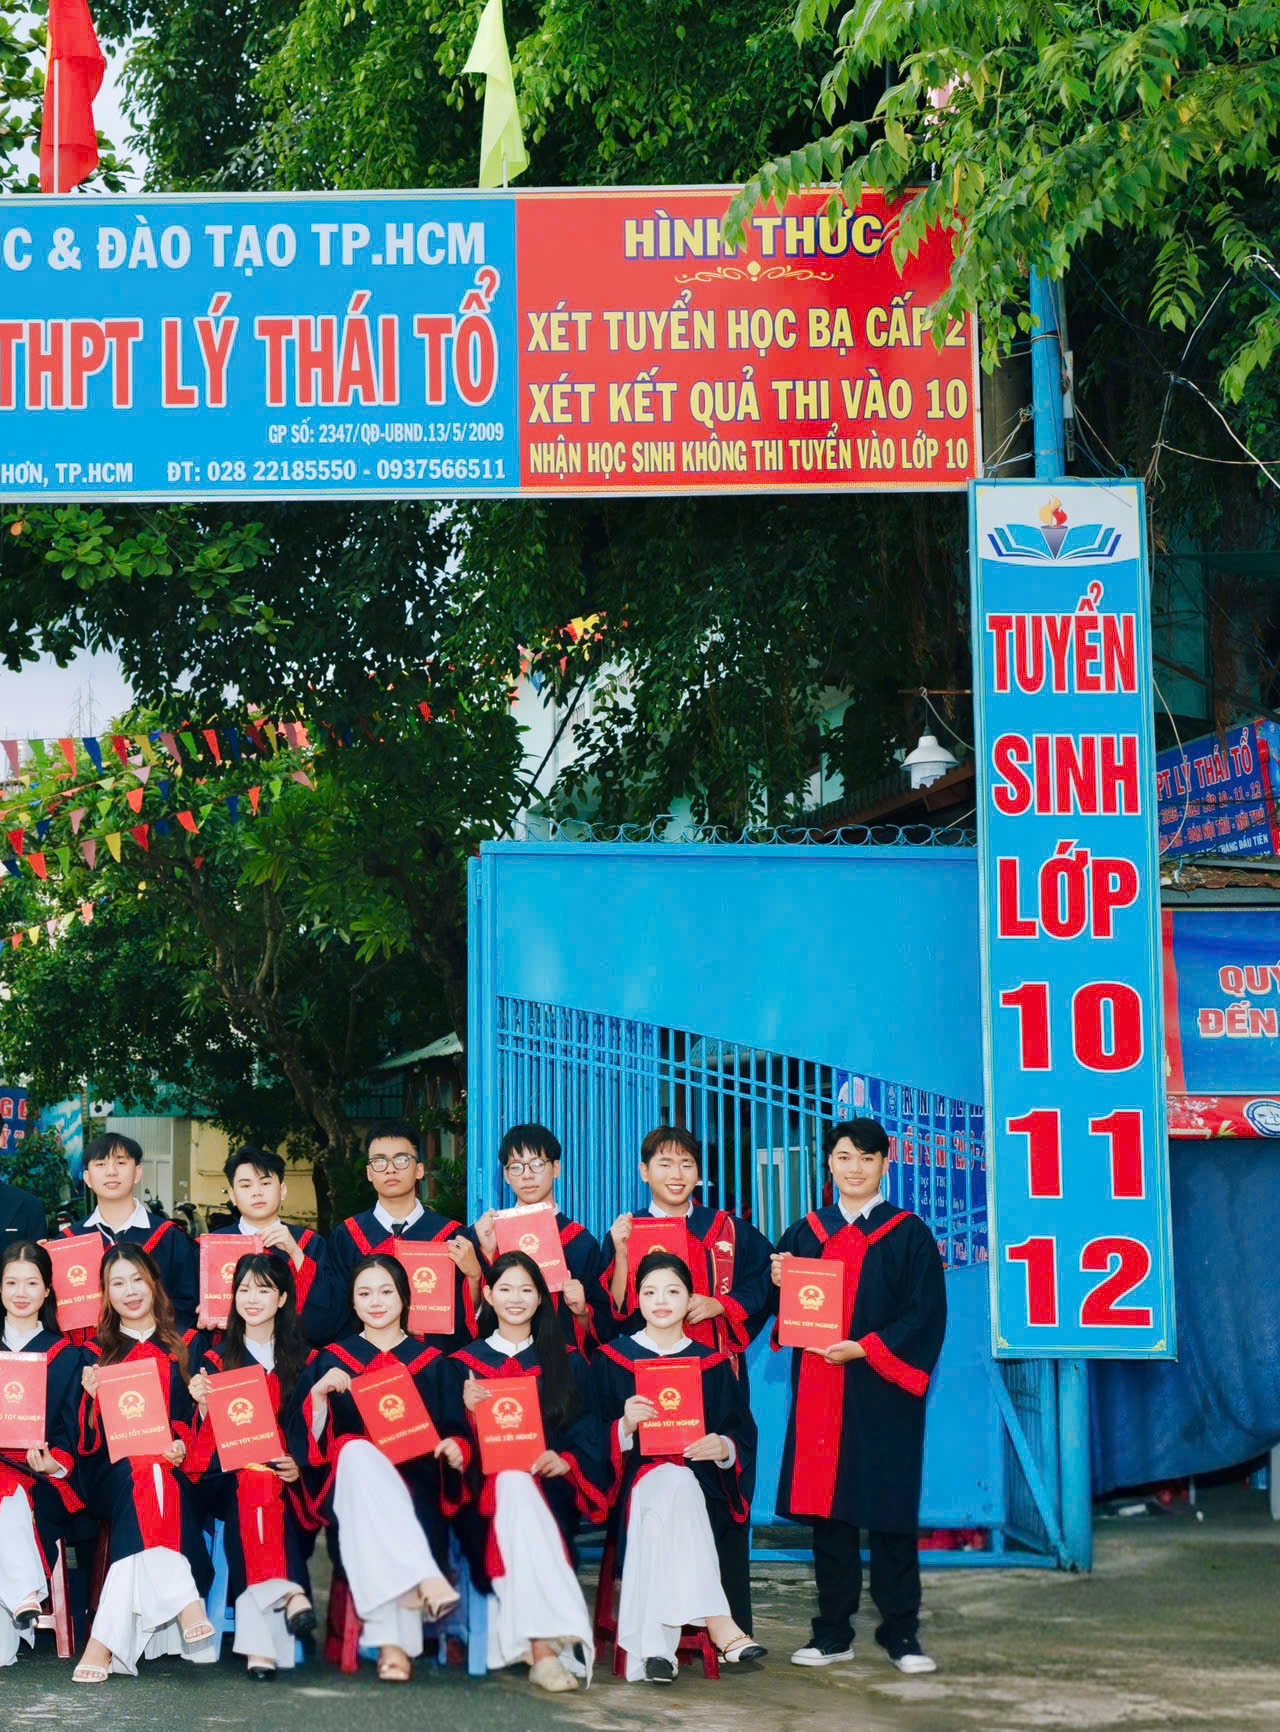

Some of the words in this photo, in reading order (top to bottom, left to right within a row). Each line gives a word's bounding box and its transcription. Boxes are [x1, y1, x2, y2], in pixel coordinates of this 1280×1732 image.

[47, 226, 82, 271] &
[96, 214, 192, 270] ĐÀO
[205, 223, 297, 277] TẠO
[310, 222, 485, 266] TP.HCM
[161, 291, 239, 409] LÝ
[254, 290, 400, 407] THÁI
[414, 265, 501, 407] TỔ
[527, 301, 592, 352] XÉT
[603, 289, 716, 351] TUYỂN
[727, 307, 796, 357] HỌC
[808, 308, 854, 355] BẠ
[865, 291, 933, 348] CẤP
[946, 310, 967, 347] 2
[268, 424, 288, 444] GP
[291, 417, 315, 444] SỐ:
[318, 422, 505, 443] 2347/QĐ-UBND.13/5/2009
[528, 372, 596, 424] XÉT
[608, 366, 678, 423] KẾT
[690, 365, 760, 428] QUẢ
[771, 379, 830, 421] THI
[840, 368, 912, 420] VÀO
[926, 378, 967, 419] 10
[55, 463, 133, 484] TP.HCM
[167, 461, 201, 482] ĐT:
[207, 461, 246, 481] 028
[253, 460, 357, 481] 22185550
[376, 459, 506, 480] 0937566511
[529, 434, 582, 480] NHẬN
[587, 440, 626, 480] HỌC
[632, 440, 676, 473] SINH
[681, 432, 747, 473] KHÔNG
[752, 440, 784, 472] THI
[789, 423, 853, 471] TUYỂN
[857, 430, 896, 470] VÀO
[901, 429, 938, 470] LỚP
[945, 437, 969, 469] 10
[986, 580, 1138, 696] TUYỂN
[992, 733, 1139, 817] SINH
[1156, 769, 1171, 801] PT
[1173, 755, 1192, 796] LÝ
[1194, 744, 1231, 789] THÁI
[1230, 727, 1254, 778] TỔ
[996, 847, 1139, 940] LỚP
[1001, 979, 1144, 1073] 10
[1197, 1000, 1278, 1038] ĐẾN
[1006, 1108, 1146, 1200] 11
[1005, 1235, 1153, 1328] 12
